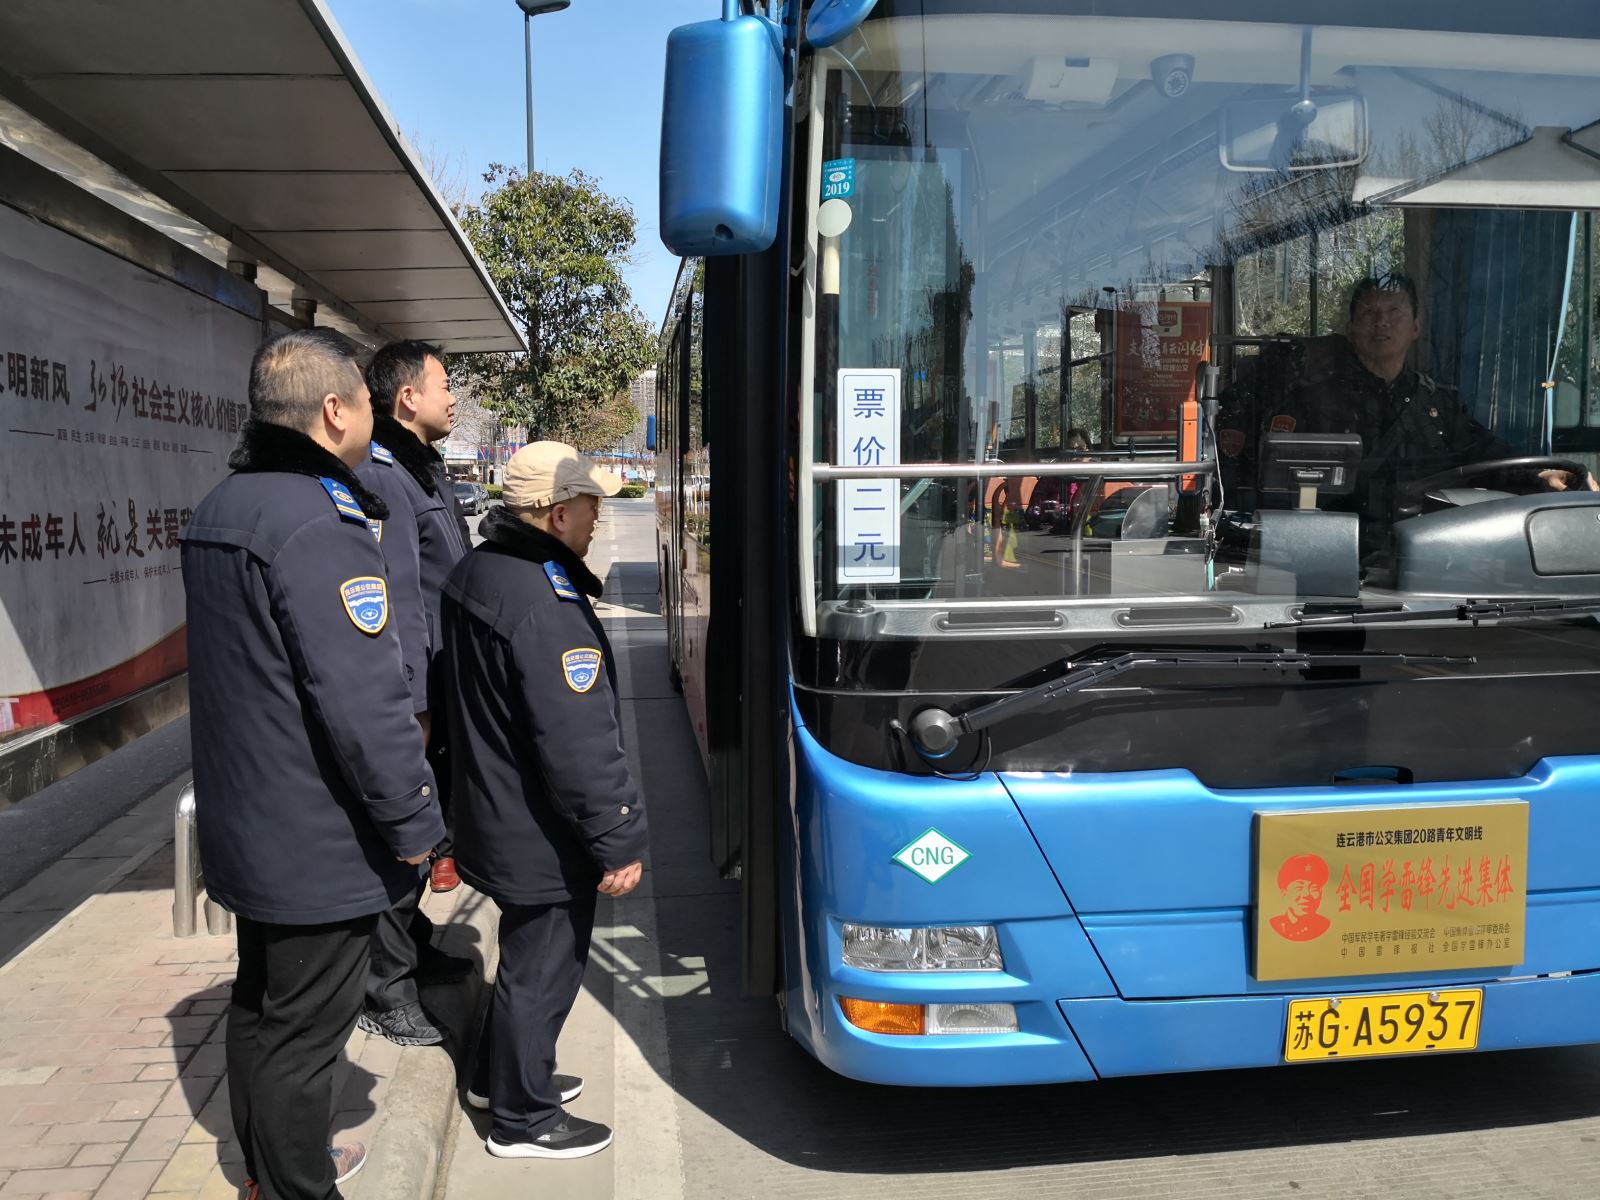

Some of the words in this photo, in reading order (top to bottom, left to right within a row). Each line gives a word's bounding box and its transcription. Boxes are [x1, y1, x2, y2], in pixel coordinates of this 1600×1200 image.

[825, 181, 850, 197] 2019
[853, 388, 886, 562] 票价二元
[1336, 826, 1483, 848] 连云港市公交集团20路青年文明线
[911, 846, 953, 865] CNG
[1335, 854, 1514, 912] 全国学雷锋先进集体
